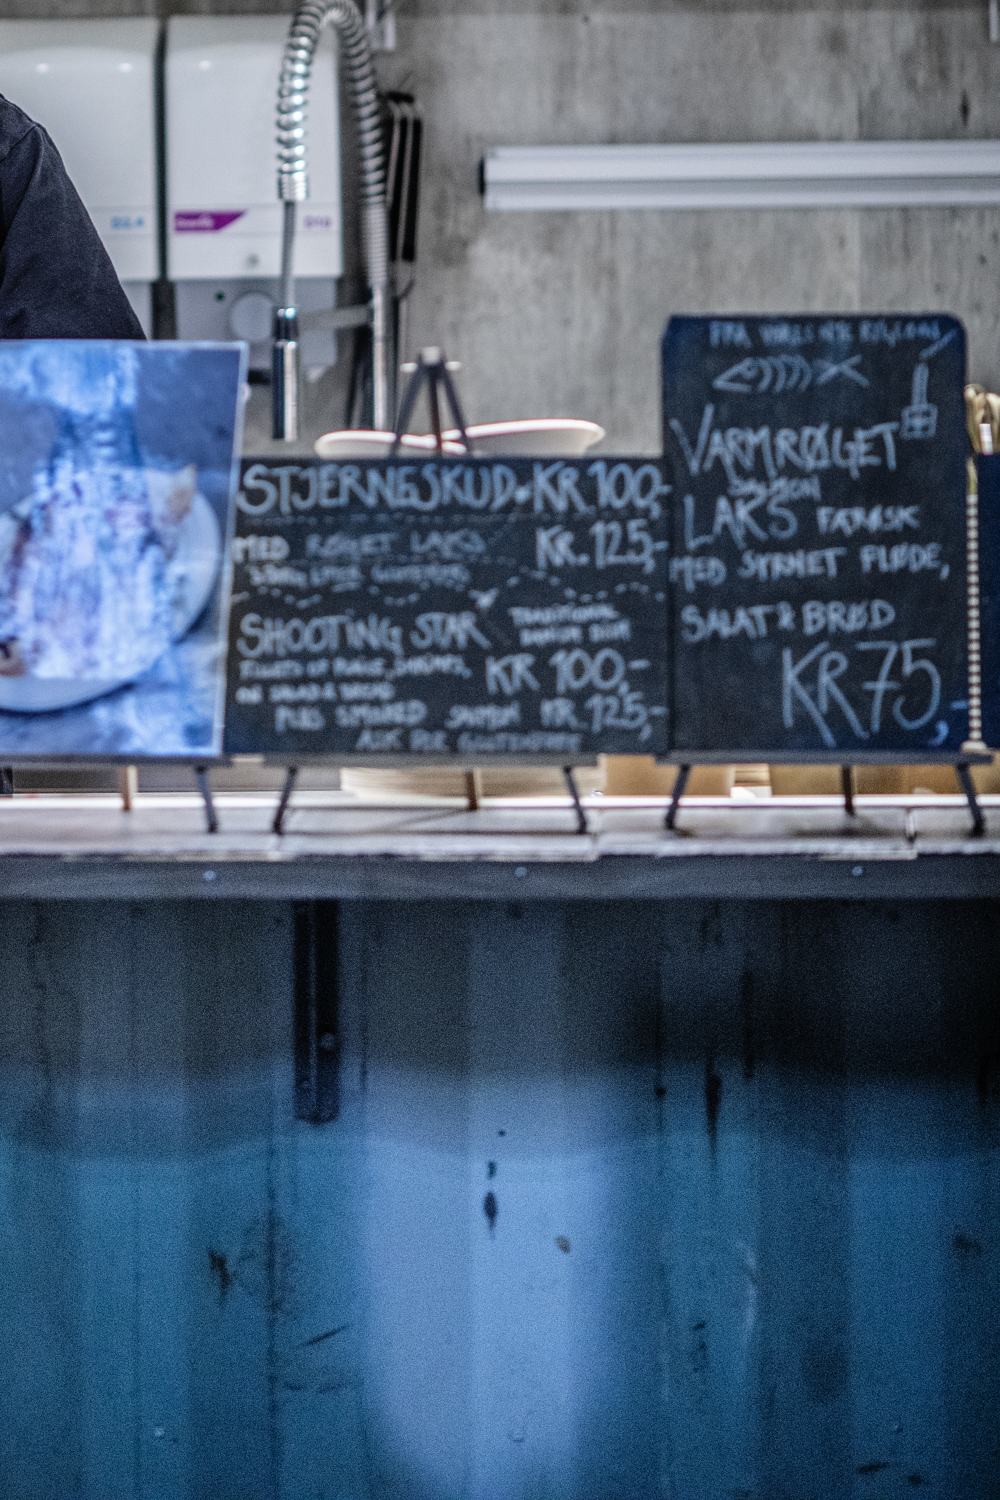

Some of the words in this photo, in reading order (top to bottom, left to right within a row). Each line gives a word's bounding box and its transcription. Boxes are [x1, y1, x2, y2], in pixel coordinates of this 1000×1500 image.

[683, 493, 799, 551] LAKS
[668, 555, 728, 592] MED
[409, 611, 492, 649] STAR
[681, 602, 774, 643] SALAT
[800, 599, 897, 637] BRØD
